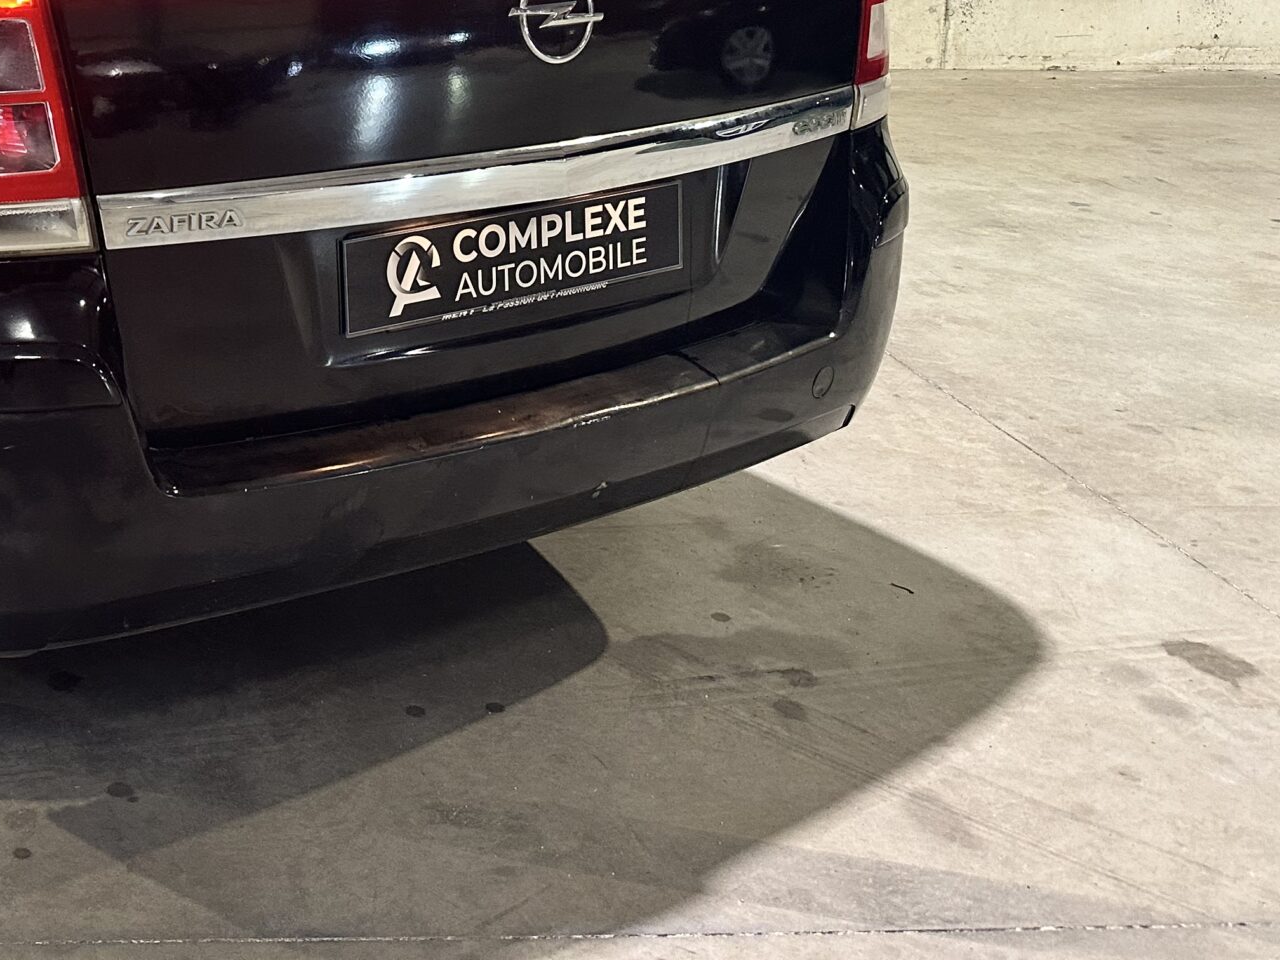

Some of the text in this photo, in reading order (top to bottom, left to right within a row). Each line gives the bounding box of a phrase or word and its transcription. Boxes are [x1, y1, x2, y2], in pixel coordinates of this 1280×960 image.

[126, 209, 244, 237] ZAFIRA
[452, 196, 648, 263] COMPLEXE
[454, 237, 648, 302] AUTOMOBILE
